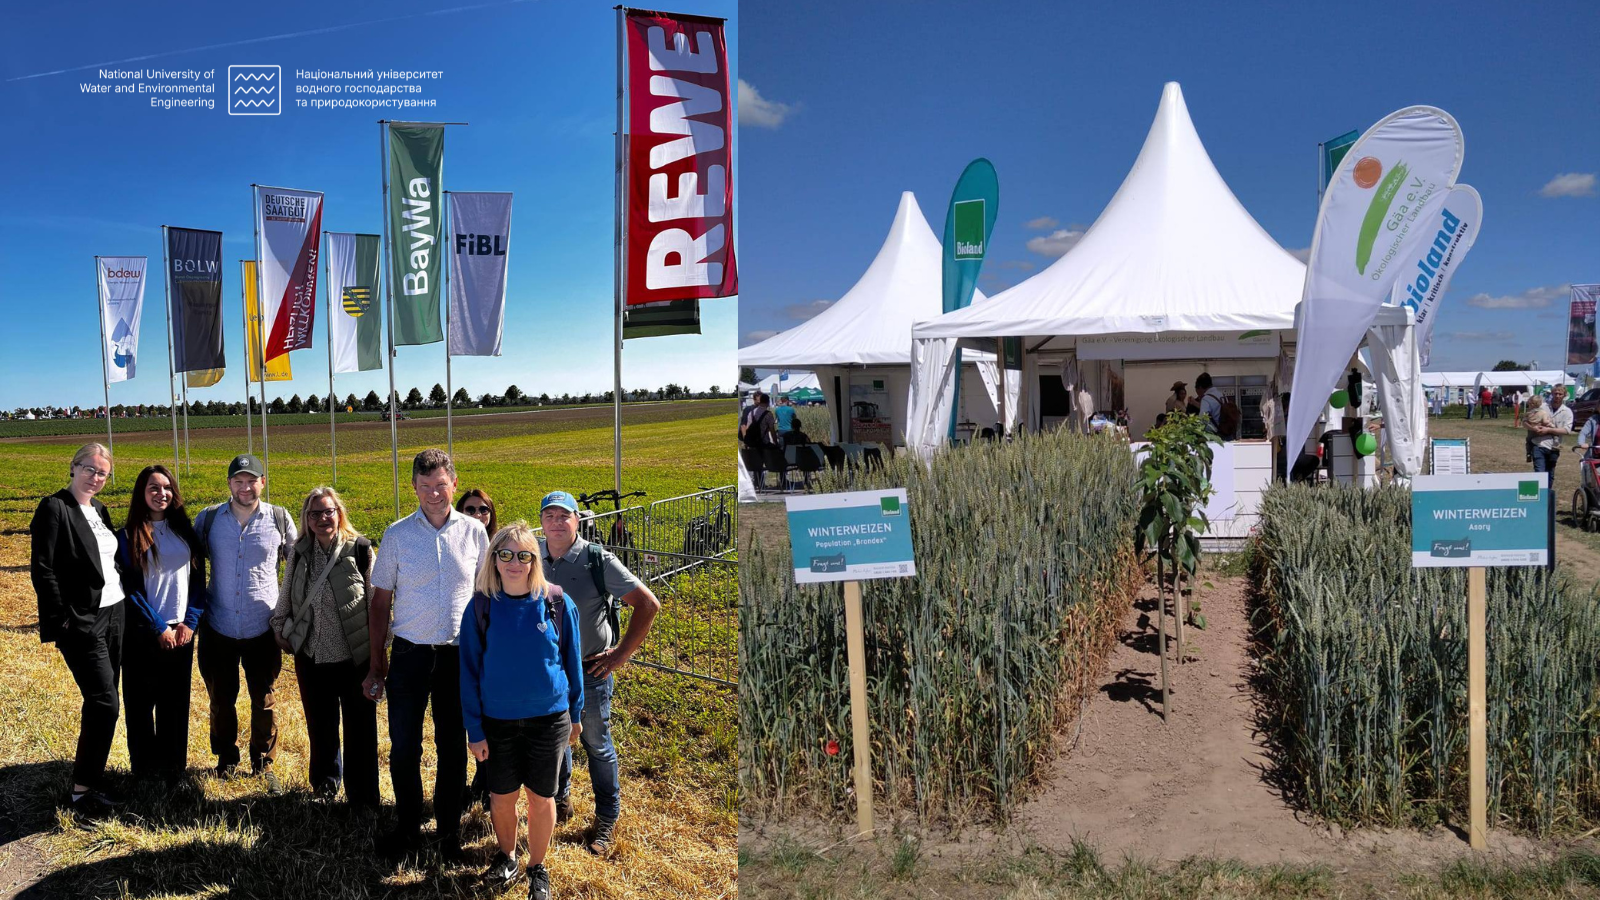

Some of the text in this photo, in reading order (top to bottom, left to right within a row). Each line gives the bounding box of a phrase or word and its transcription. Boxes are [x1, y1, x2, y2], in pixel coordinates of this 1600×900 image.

[645, 25, 726, 290] REWE
[265, 194, 305, 207] DEUTSCHE
[1386, 204, 1409, 231] Gäa
[1406, 176, 1426, 202] e.V.
[265, 204, 306, 217] SAATGUT
[401, 177, 436, 296] BayWa
[1371, 223, 1410, 281] Ökologischer
[1407, 182, 1436, 223] Landbau
[455, 232, 506, 256] FiBL
[956, 240, 983, 256] Bioland
[107, 267, 141, 278] bdew
[1416, 308, 1428, 324] klar
[1426, 273, 1444, 303] kritisch
[1443, 222, 1469, 267] konstruktiv
[1197, 334, 1225, 342] Landbau
[1432, 507, 1527, 519] WINTERWEIZEN
[807, 522, 892, 538] WINTERWEIZEN
[1468, 523, 1491, 531] Asory
[815, 540, 852, 549] Population
